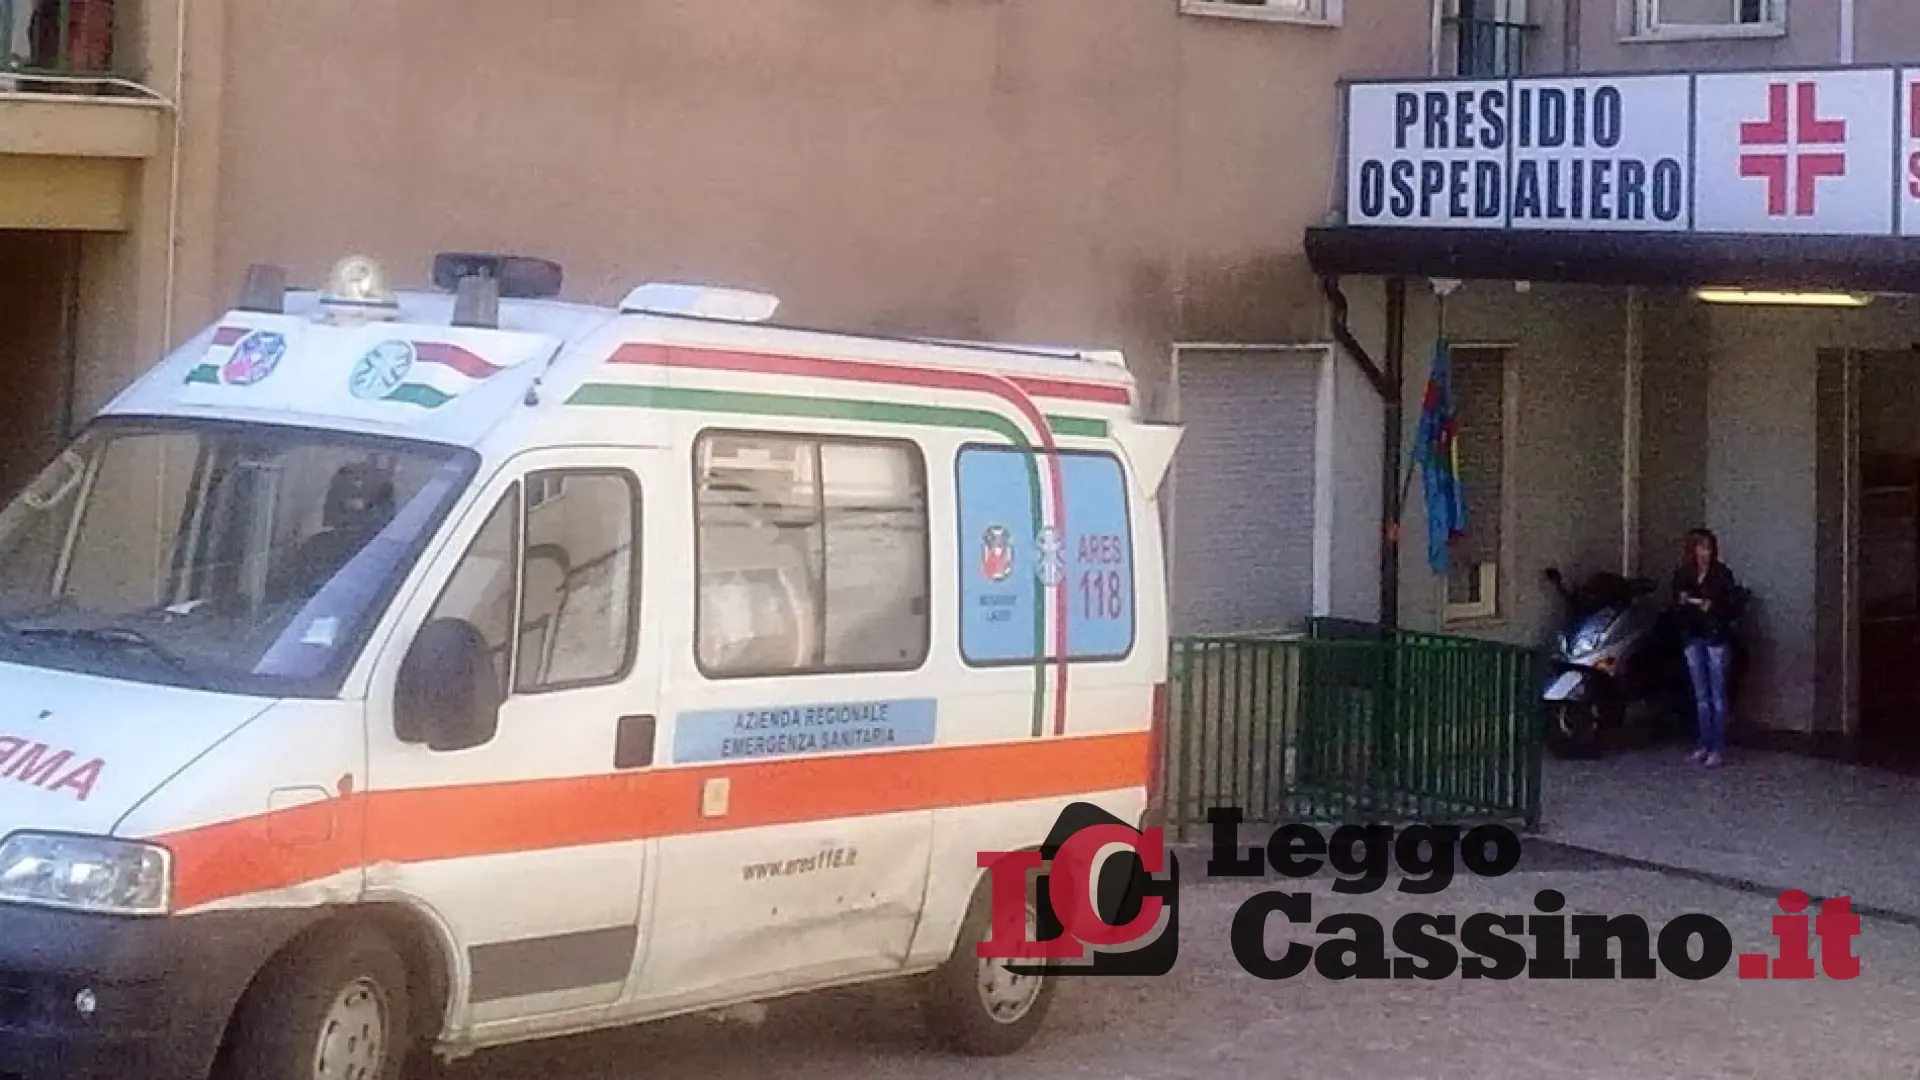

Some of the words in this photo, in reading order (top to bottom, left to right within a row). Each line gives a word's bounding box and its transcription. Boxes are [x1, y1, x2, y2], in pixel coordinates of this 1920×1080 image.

[1395, 86, 1623, 149] PRESIDIO
[1359, 157, 1682, 221] OSPEDALIERO
[1078, 534, 1122, 564] ARES
[1080, 570, 1122, 620] 118
[734, 708, 800, 731] AZIENDA
[804, 703, 889, 727] REGIONALE
[721, 734, 816, 757] EMERGENZA
[821, 727, 895, 749] SANITARIA
[743, 847, 858, 881] www.ares118.it
